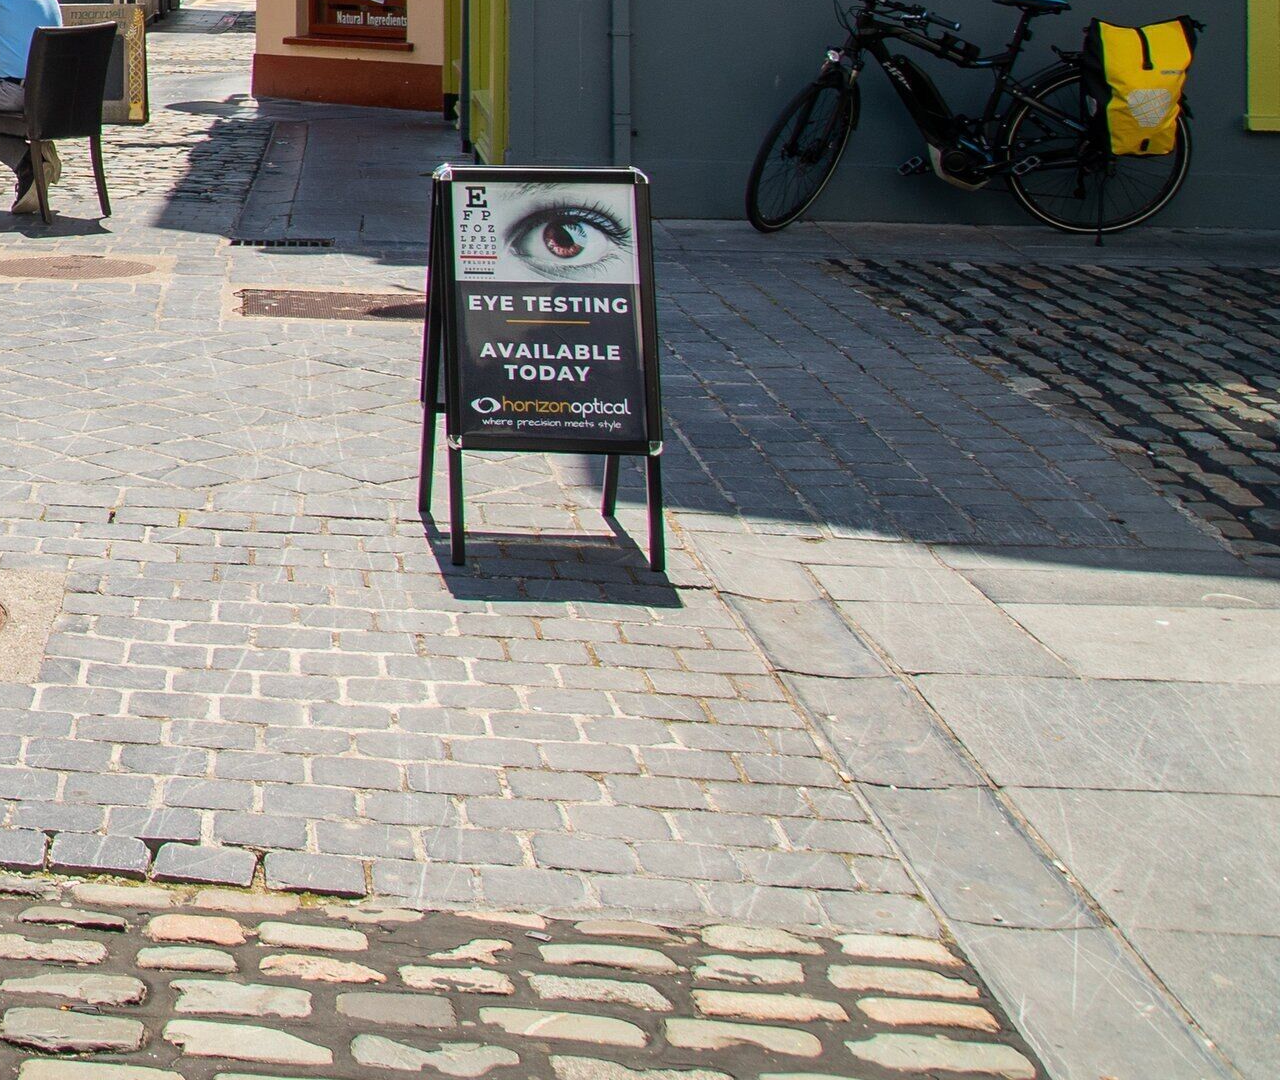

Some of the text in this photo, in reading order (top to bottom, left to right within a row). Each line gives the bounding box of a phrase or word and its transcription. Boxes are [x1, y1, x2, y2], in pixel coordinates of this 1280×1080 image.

[336, 10, 407, 27] Natural Ingredients
[465, 186, 488, 208] E
[468, 295, 628, 313] EYE TESTING
[479, 342, 621, 361] AVAILABLE
[504, 364, 591, 382] TODAY
[481, 417, 623, 432] where precision meets style
